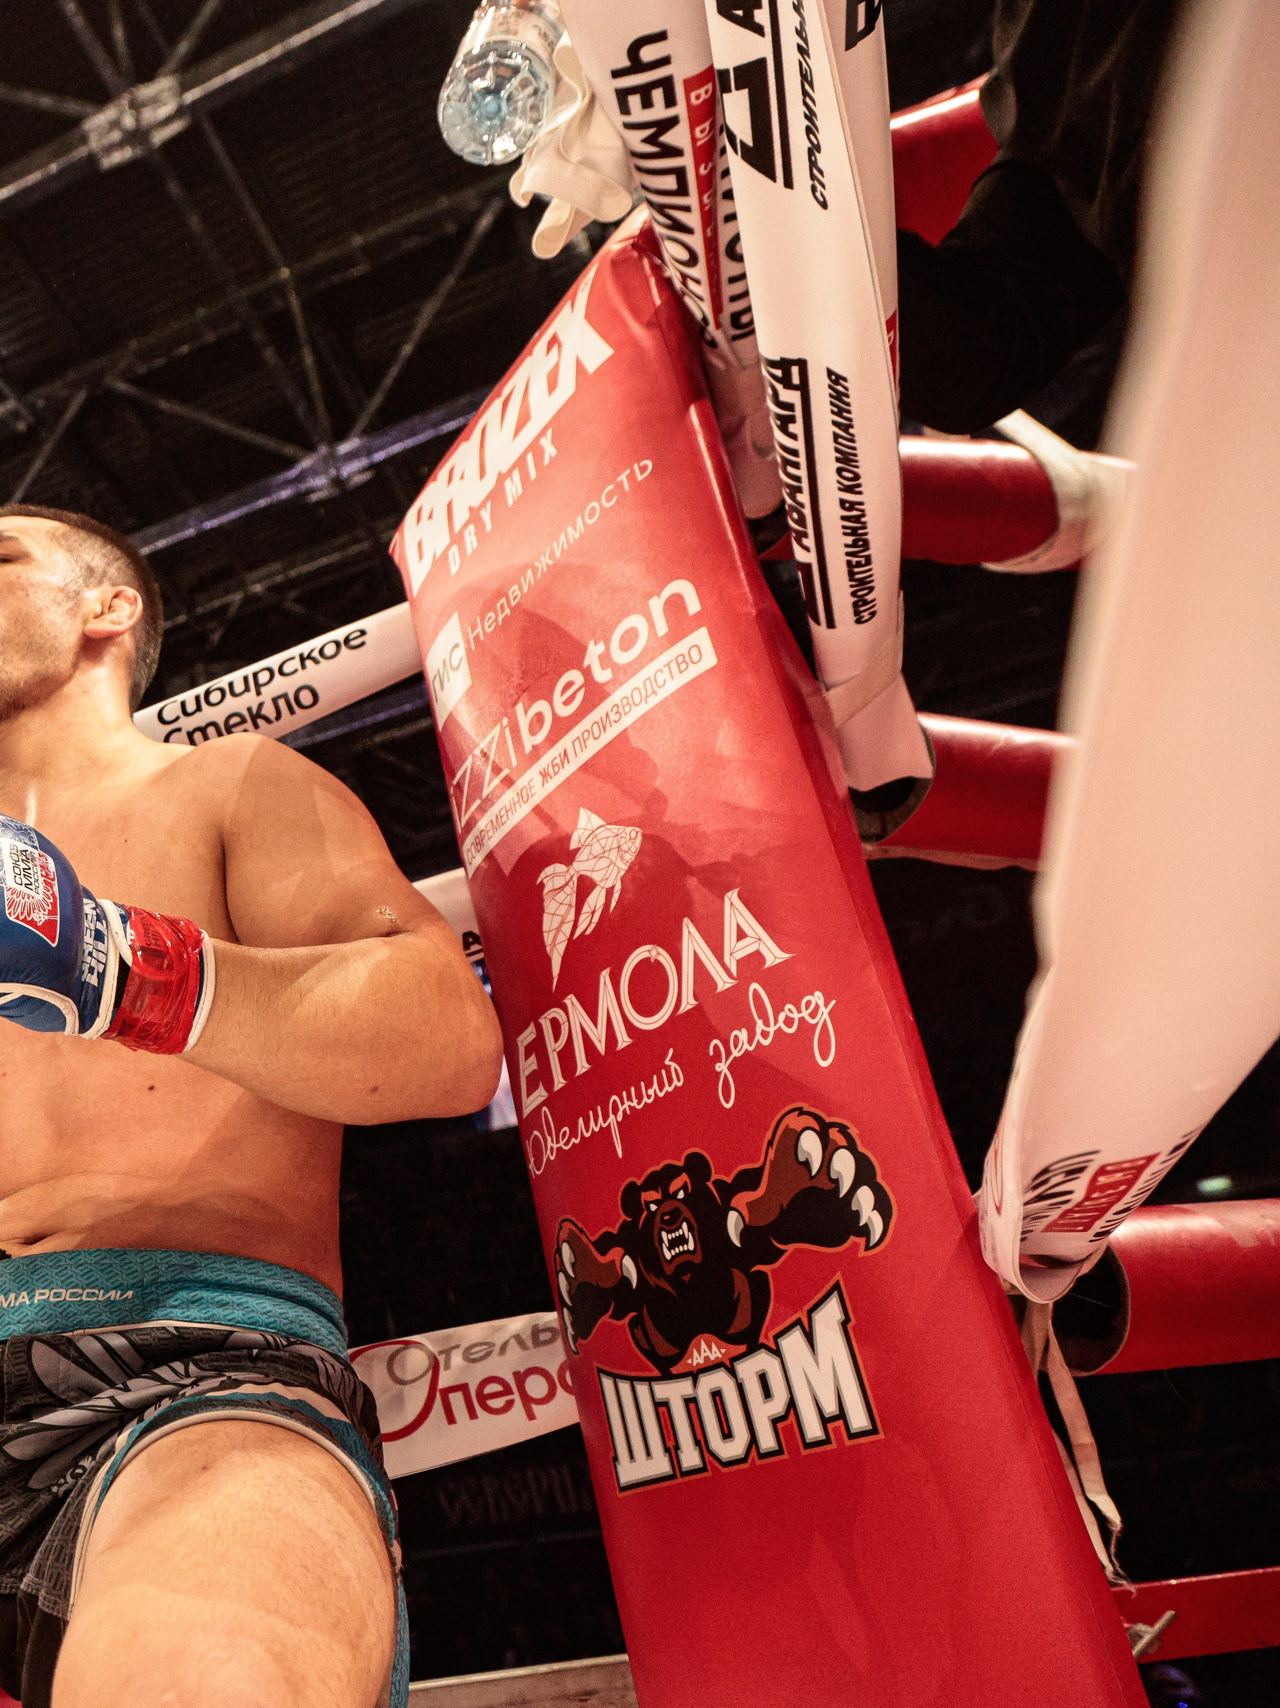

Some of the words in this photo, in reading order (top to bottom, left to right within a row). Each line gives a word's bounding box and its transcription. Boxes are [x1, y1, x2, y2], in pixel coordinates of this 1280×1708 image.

[826, 367, 863, 496] КОМПАНИЯ
[448, 499, 492, 576] DRY
[504, 428, 558, 507] MIX
[839, 497, 878, 625] СТРОИТЕЛЬНАЯ
[539, 748, 570, 788] ЖБИ
[571, 644, 703, 758] ПРОИЗВОДСТВО
[20, 849, 34, 891] ММА
[516, 887, 797, 1119] ЕРМОЛА
[709, 982, 837, 1109] завод
[34, 1288, 133, 1304] РОССИИ
[386, 1323, 561, 1386] Отель
[598, 1288, 875, 1488] ШТОРМ
